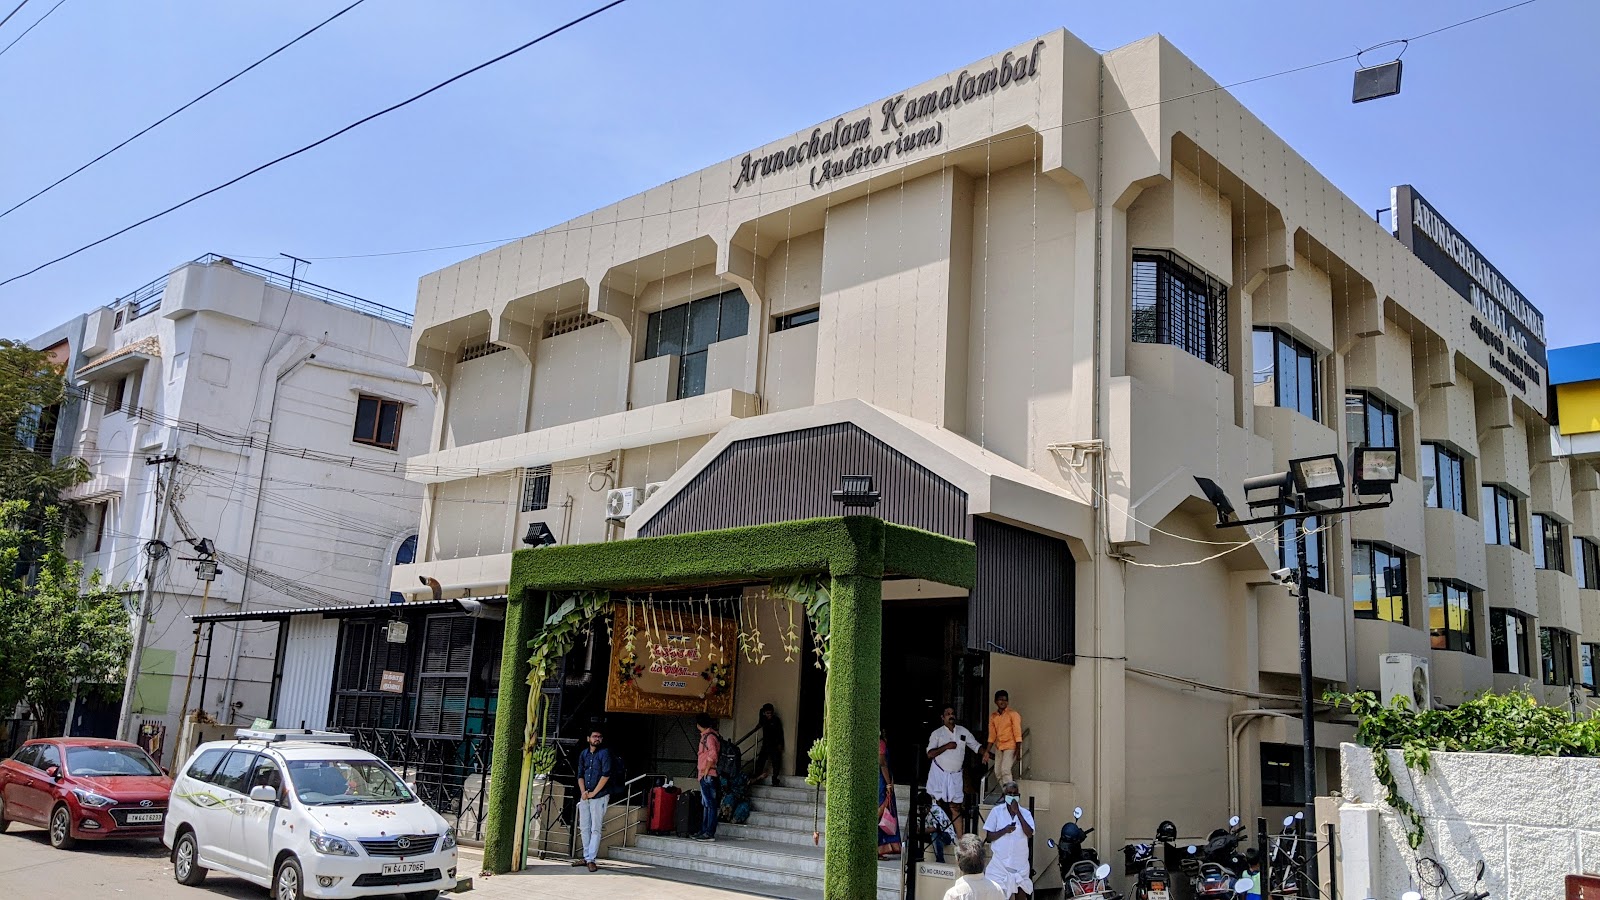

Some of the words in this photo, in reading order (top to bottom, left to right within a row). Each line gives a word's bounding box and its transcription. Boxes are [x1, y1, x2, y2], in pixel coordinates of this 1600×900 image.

[733, 116, 872, 190] Arunachalam
[880, 39, 1044, 131] Kamalambal
[809, 121, 944, 187] (Auditorium)
[1413, 198, 1491, 291] ARUNACHALAM
[1490, 271, 1547, 346] KAMALAMBAL
[1470, 283, 1508, 337] MAHAL
[1509, 326, 1528, 354] A/C
